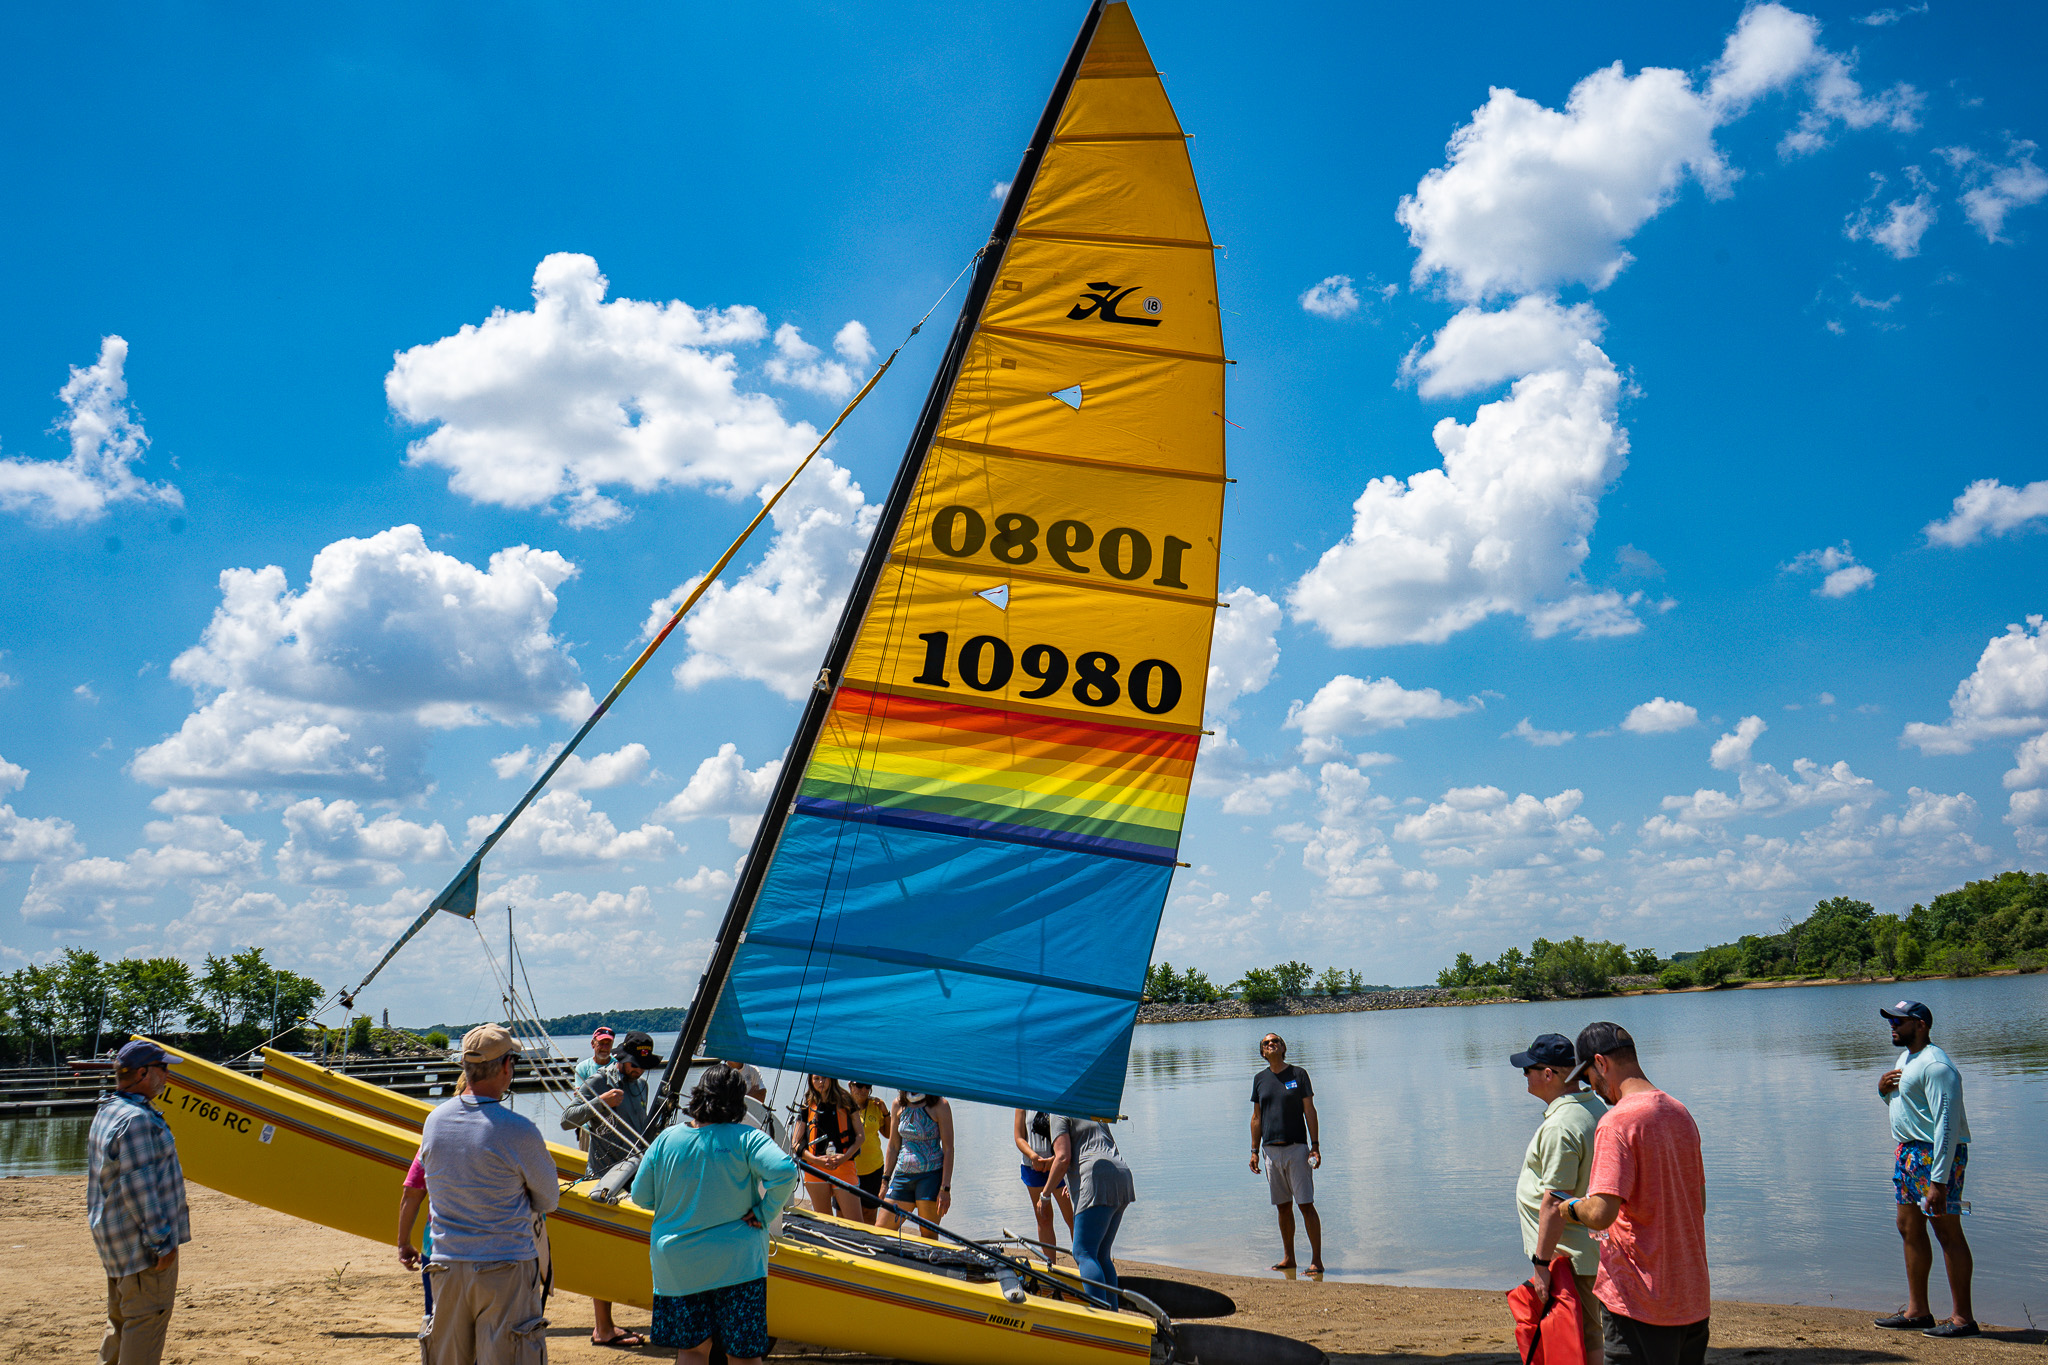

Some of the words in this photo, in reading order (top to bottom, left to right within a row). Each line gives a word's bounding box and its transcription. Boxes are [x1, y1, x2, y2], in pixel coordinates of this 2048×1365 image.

[1147, 300, 1158, 311] 18
[913, 632, 1182, 714] 10980
[181, 1094, 221, 1122] 1766
[223, 1111, 251, 1134] RC
